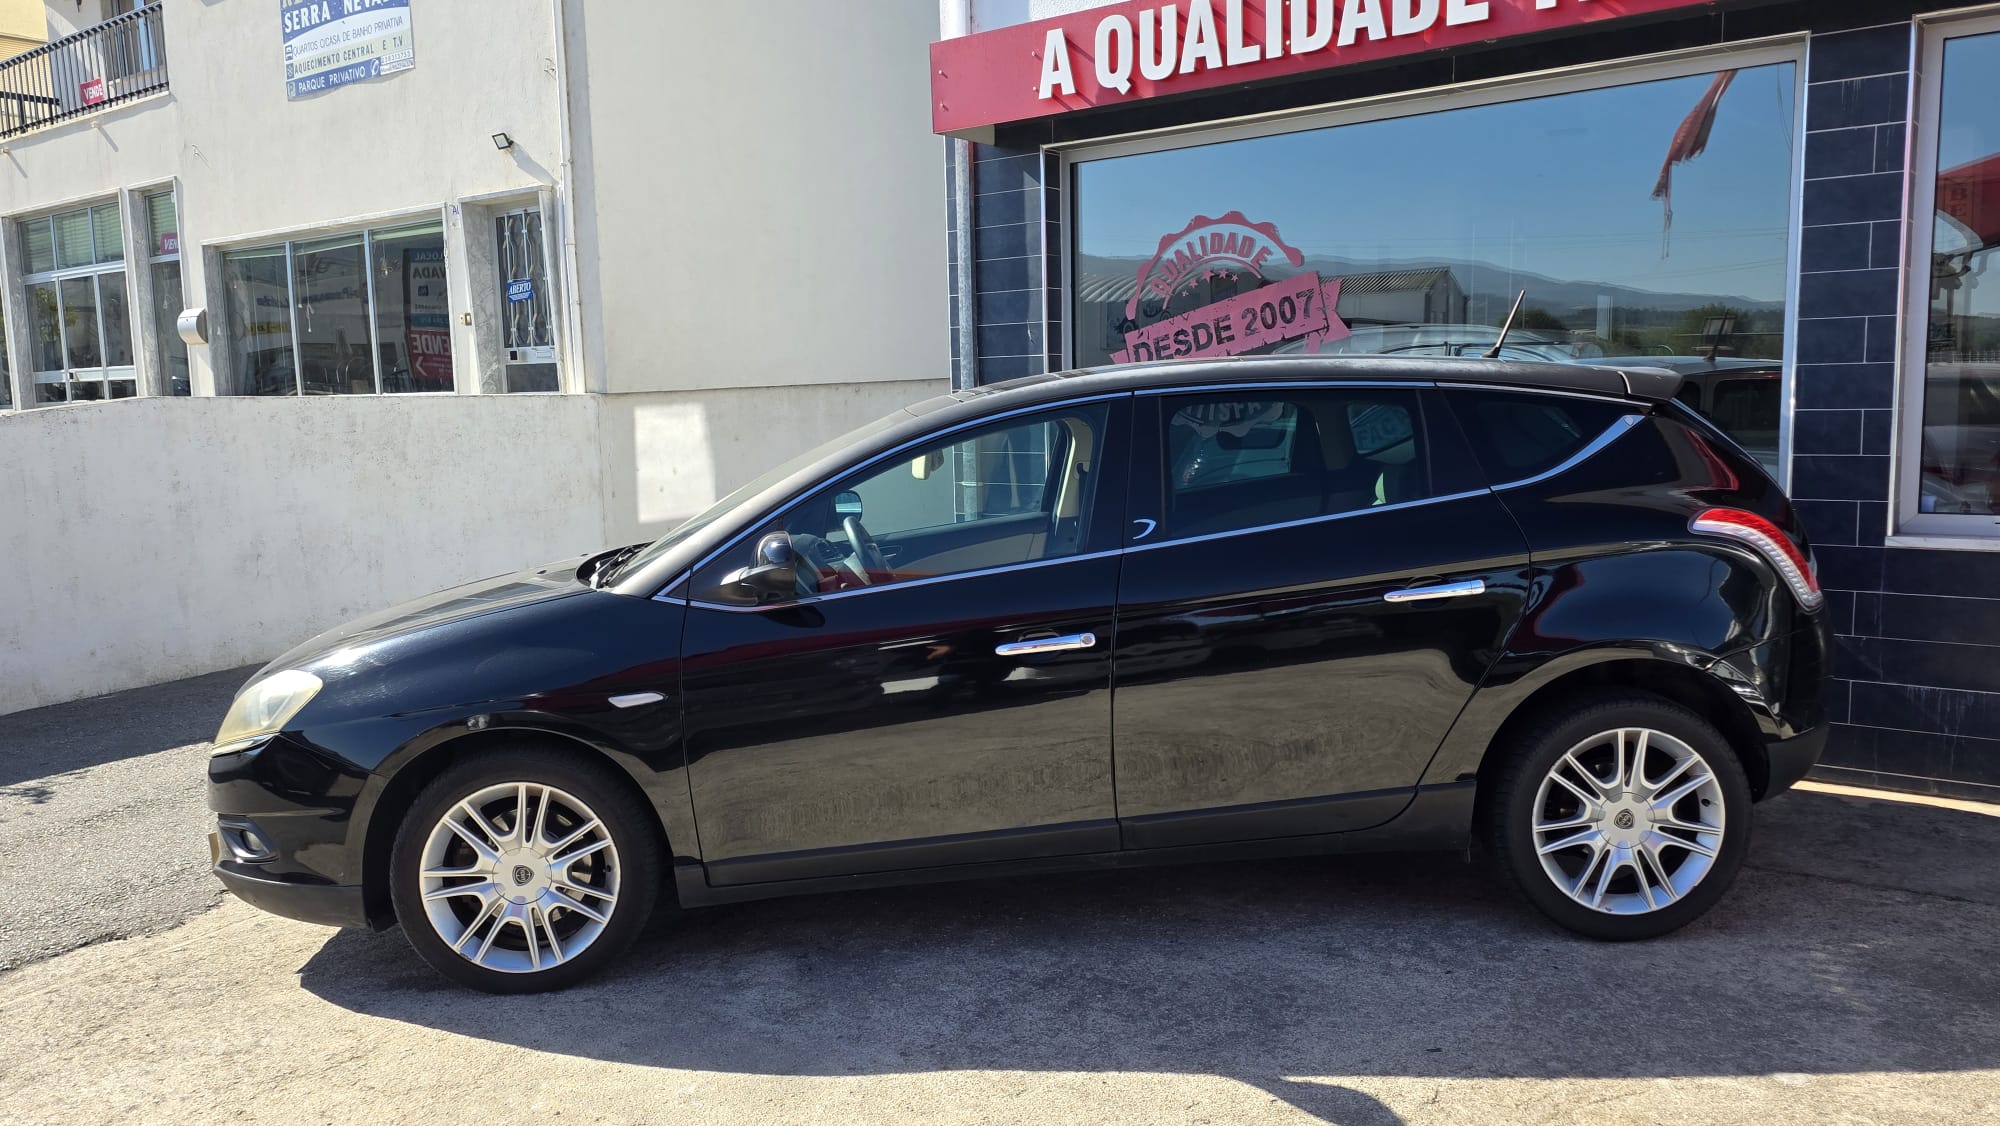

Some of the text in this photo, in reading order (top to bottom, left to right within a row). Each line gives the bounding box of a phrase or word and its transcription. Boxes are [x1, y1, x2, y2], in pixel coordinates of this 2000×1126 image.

[284, 1, 331, 33] SERRA
[293, 40, 318, 57] QUARTOS
[342, 31, 351, 41] DE
[352, 25, 373, 39] BANHO
[374, 16, 403, 32] PRIVATIVA
[294, 53, 341, 75] AQUECIMENTO
[343, 44, 374, 61] CENTRAL
[382, 39, 387, 50] E
[1038, 27, 1077, 100] A
[83, 83, 104, 100] VENDE
[298, 76, 326, 93] PARQUE
[329, 66, 366, 85] PRIVATIVO
[1151, 231, 1273, 297] QUALIDADE
[508, 281, 531, 295] ABERTO
[1132, 288, 1315, 363] DESDE 2007
